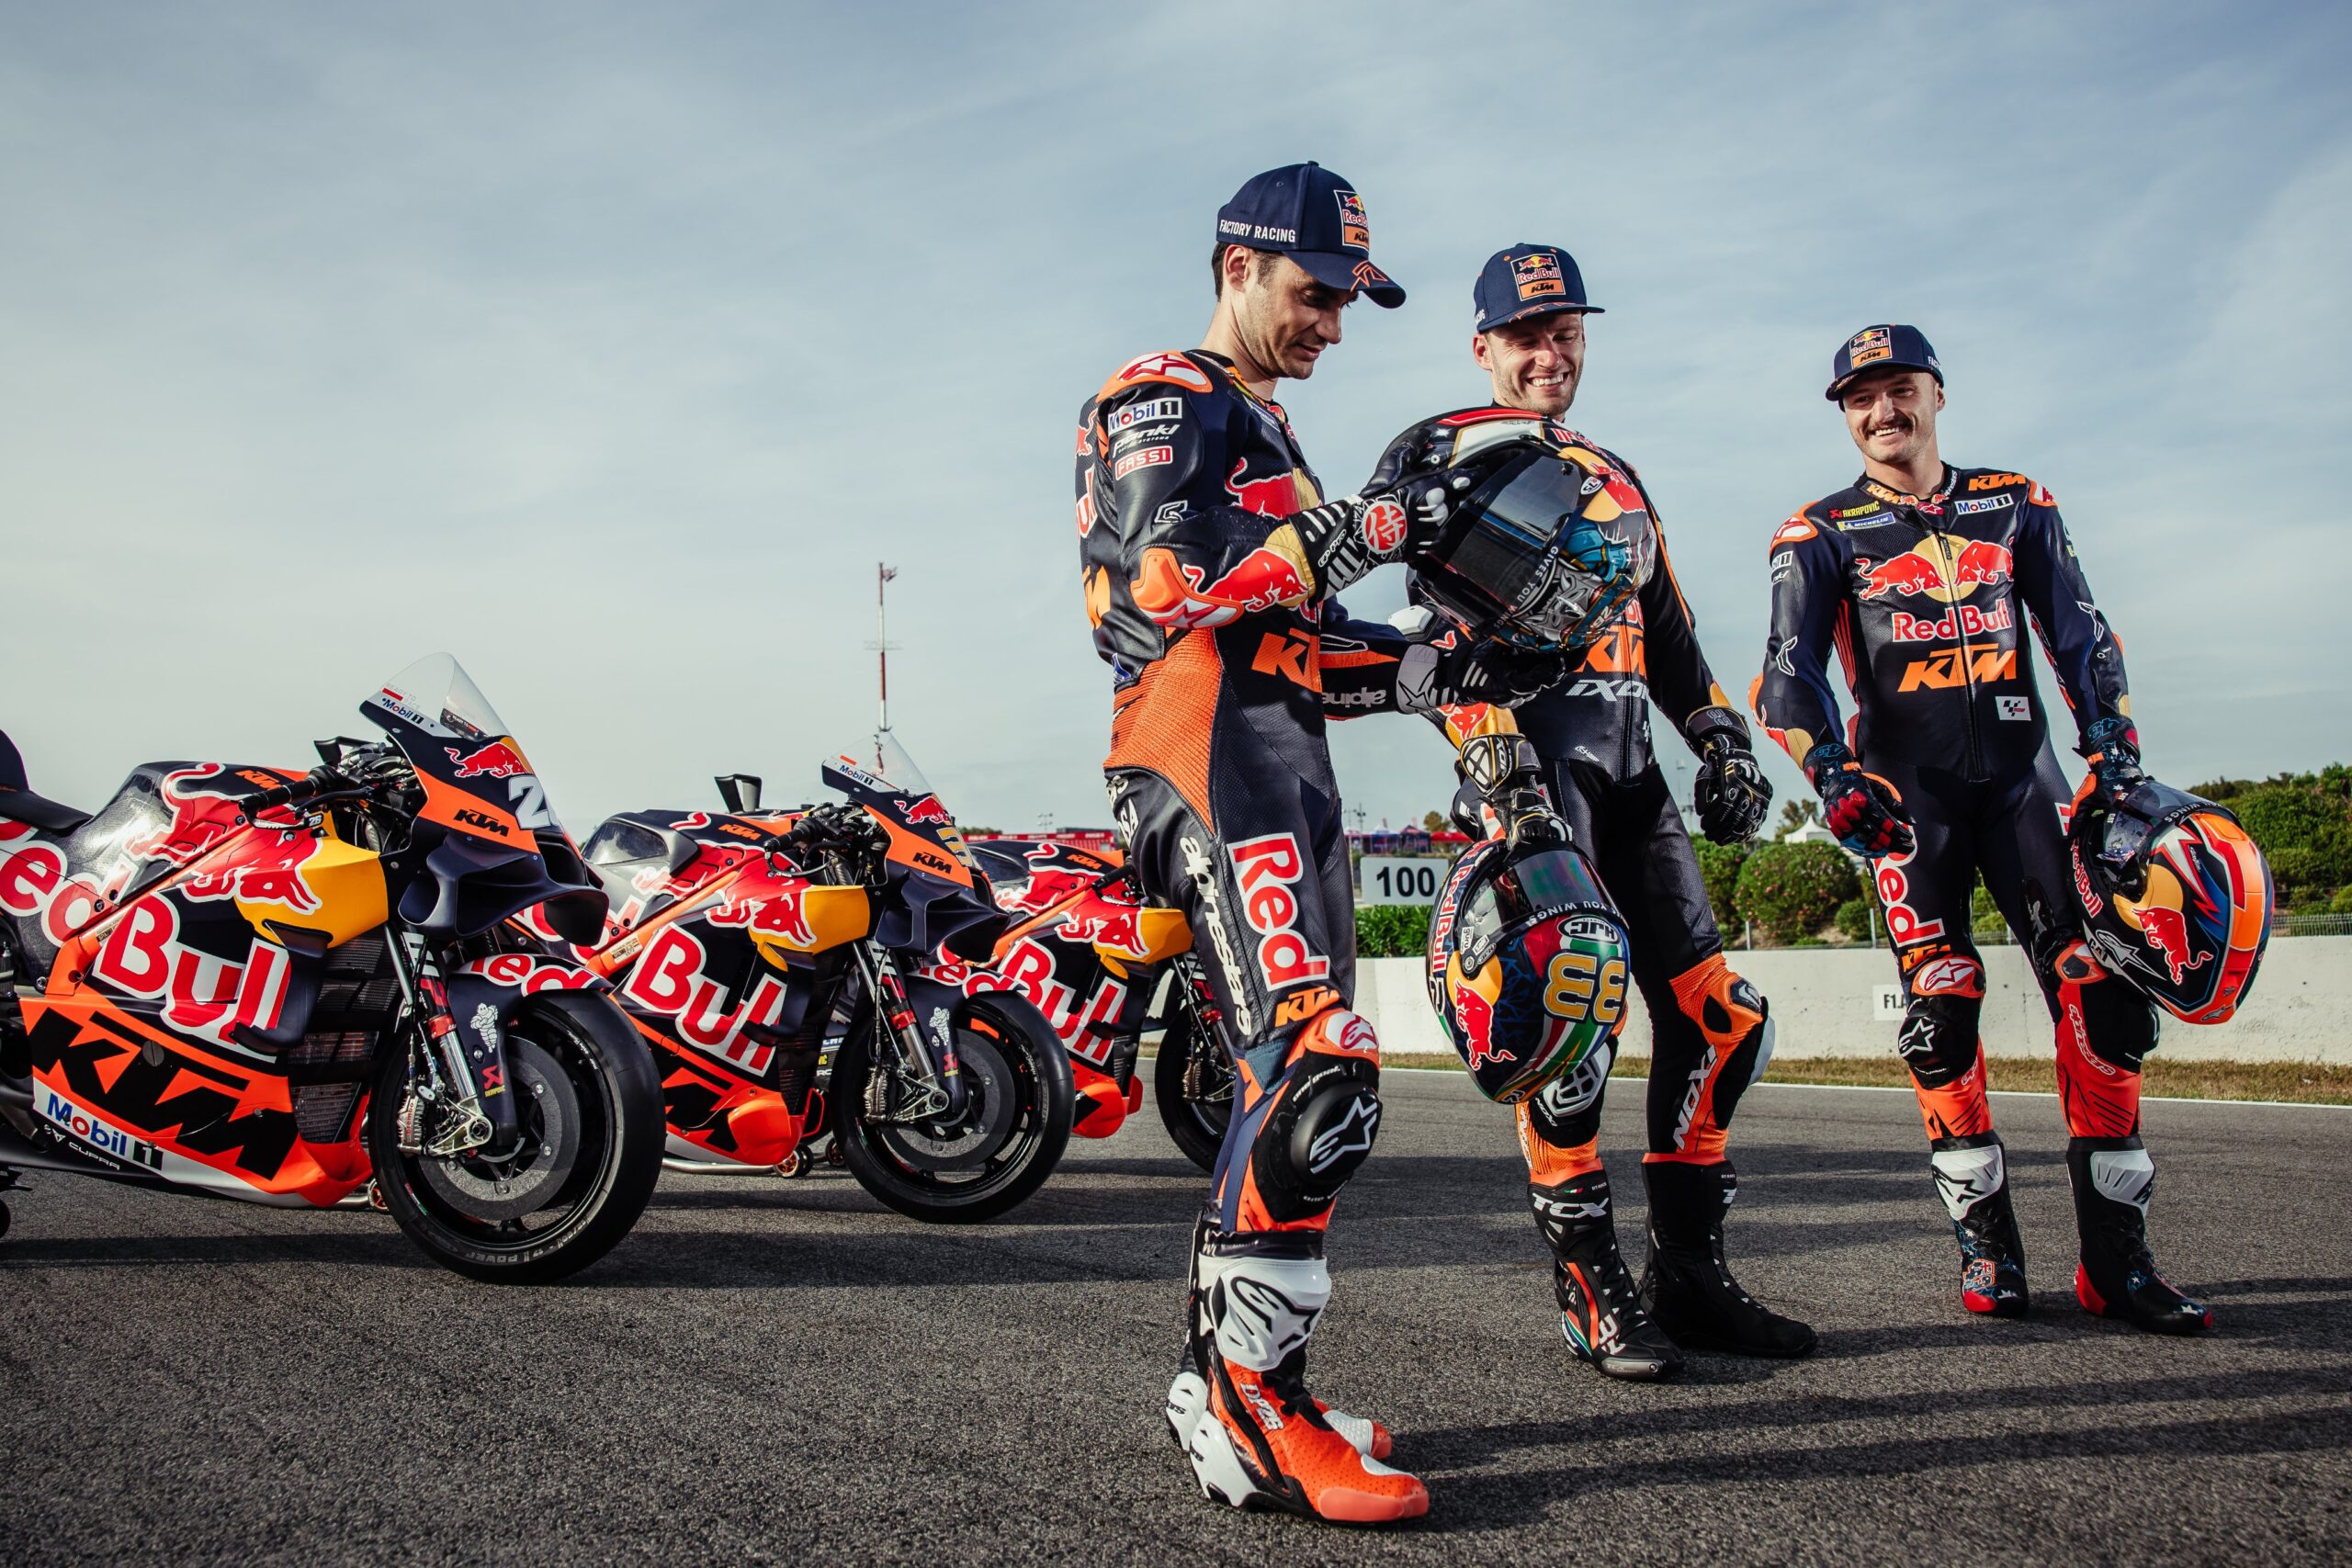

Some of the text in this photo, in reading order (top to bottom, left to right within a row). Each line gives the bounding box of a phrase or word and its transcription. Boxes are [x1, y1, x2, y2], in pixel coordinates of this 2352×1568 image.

[1219, 219, 1295, 243] FACTORY RACING
[1531, 282, 1555, 293] KTM
[1860, 351, 1881, 362] KTM
[1109, 402, 1156, 431] Mobil
[1118, 449, 1166, 475] FASSI
[1867, 484, 1901, 504] KTM
[1968, 473, 2026, 491] KTM
[1958, 499, 1996, 513] Mobil
[1854, 516, 1889, 527] MICHELIN
[1535, 546, 1559, 578] GIVES
[1517, 581, 1536, 602] YOU
[1892, 599, 2012, 642] Red Bull
[1897, 642, 2017, 692] KTM
[382, 699, 413, 718] Mobil
[840, 764, 865, 782] Mobil
[309, 815, 322, 827] 26
[453, 808, 510, 837] KTM
[2164, 803, 2201, 822] WINGS
[718, 823, 761, 840] KTM
[912, 852, 953, 874] KTM
[1067, 854, 1102, 869] KTM
[0, 820, 140, 947] ed
[1376, 866, 1435, 897] 100
[1440, 865, 1475, 918] Red
[2075, 865, 2104, 918] Bull
[1230, 834, 1329, 988] Red
[1525, 899, 1607, 928] YOU WINGS
[1180, 836, 1252, 1036] alpinestars
[1433, 915, 1455, 971] Bull
[1569, 921, 1617, 940] HJC
[93, 891, 290, 1055] Bull
[1544, 952, 1626, 1022] 33
[623, 923, 786, 1075] Bull
[1000, 936, 1126, 1066] Bull
[1275, 986, 1340, 1027] KTM
[28, 1007, 300, 1180] KTM
[1673, 1043, 1718, 1151] IXON
[47, 1093, 127, 1156] Mobil
[405, 1102, 414, 1135] brembo
[69, 1142, 120, 1170] CUPRA
[1532, 1193, 1610, 1218] TCX
[1240, 1383, 1284, 1430] DP26
